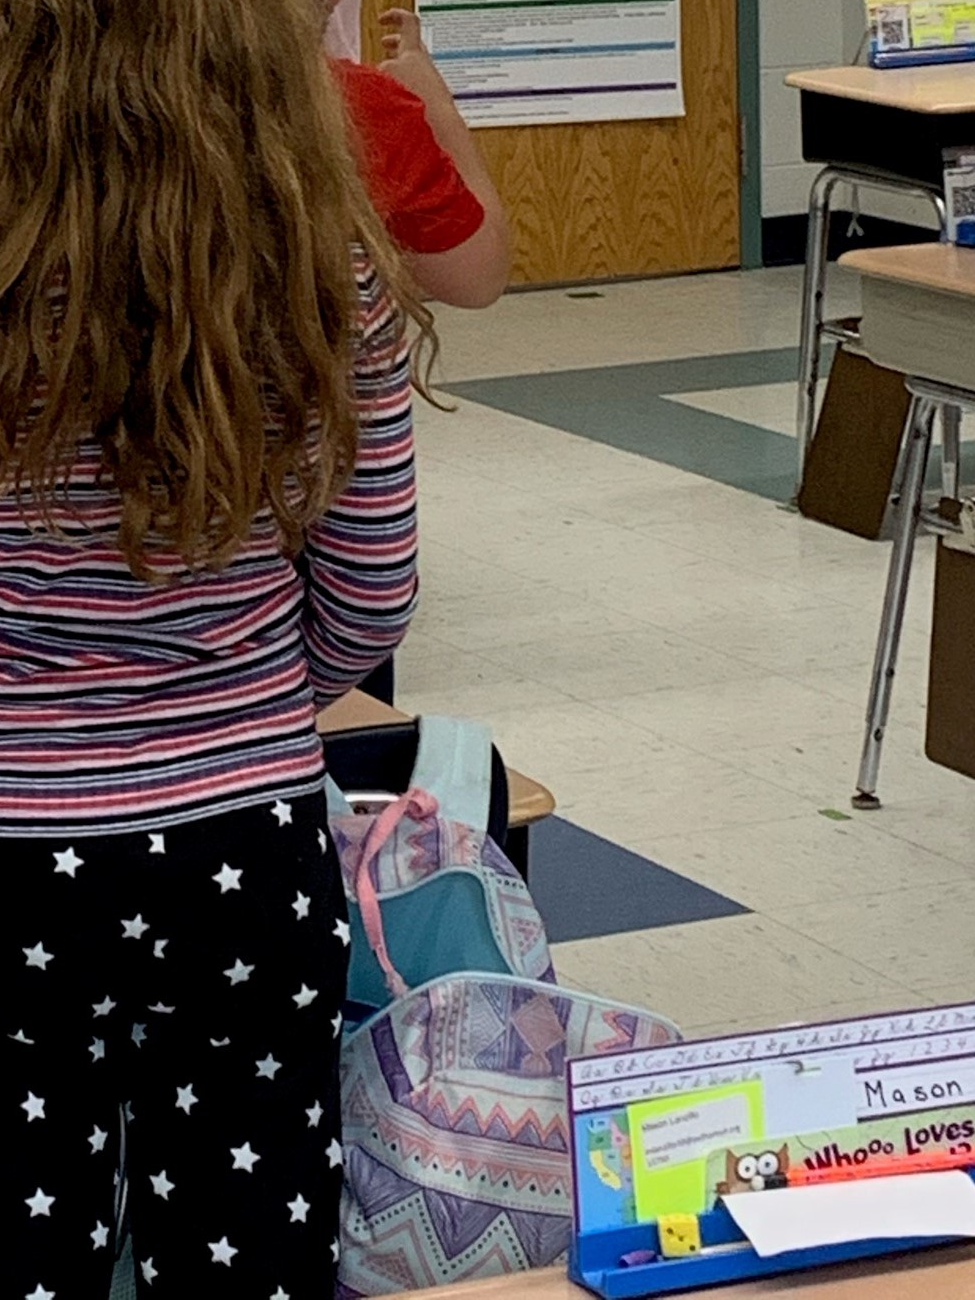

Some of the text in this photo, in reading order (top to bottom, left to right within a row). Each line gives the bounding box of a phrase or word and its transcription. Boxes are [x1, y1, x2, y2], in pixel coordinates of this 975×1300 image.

[864, 1080, 963, 1108] Mason
[804, 1139, 894, 1171] Whooo
[904, 1119, 975, 1156] Loves
